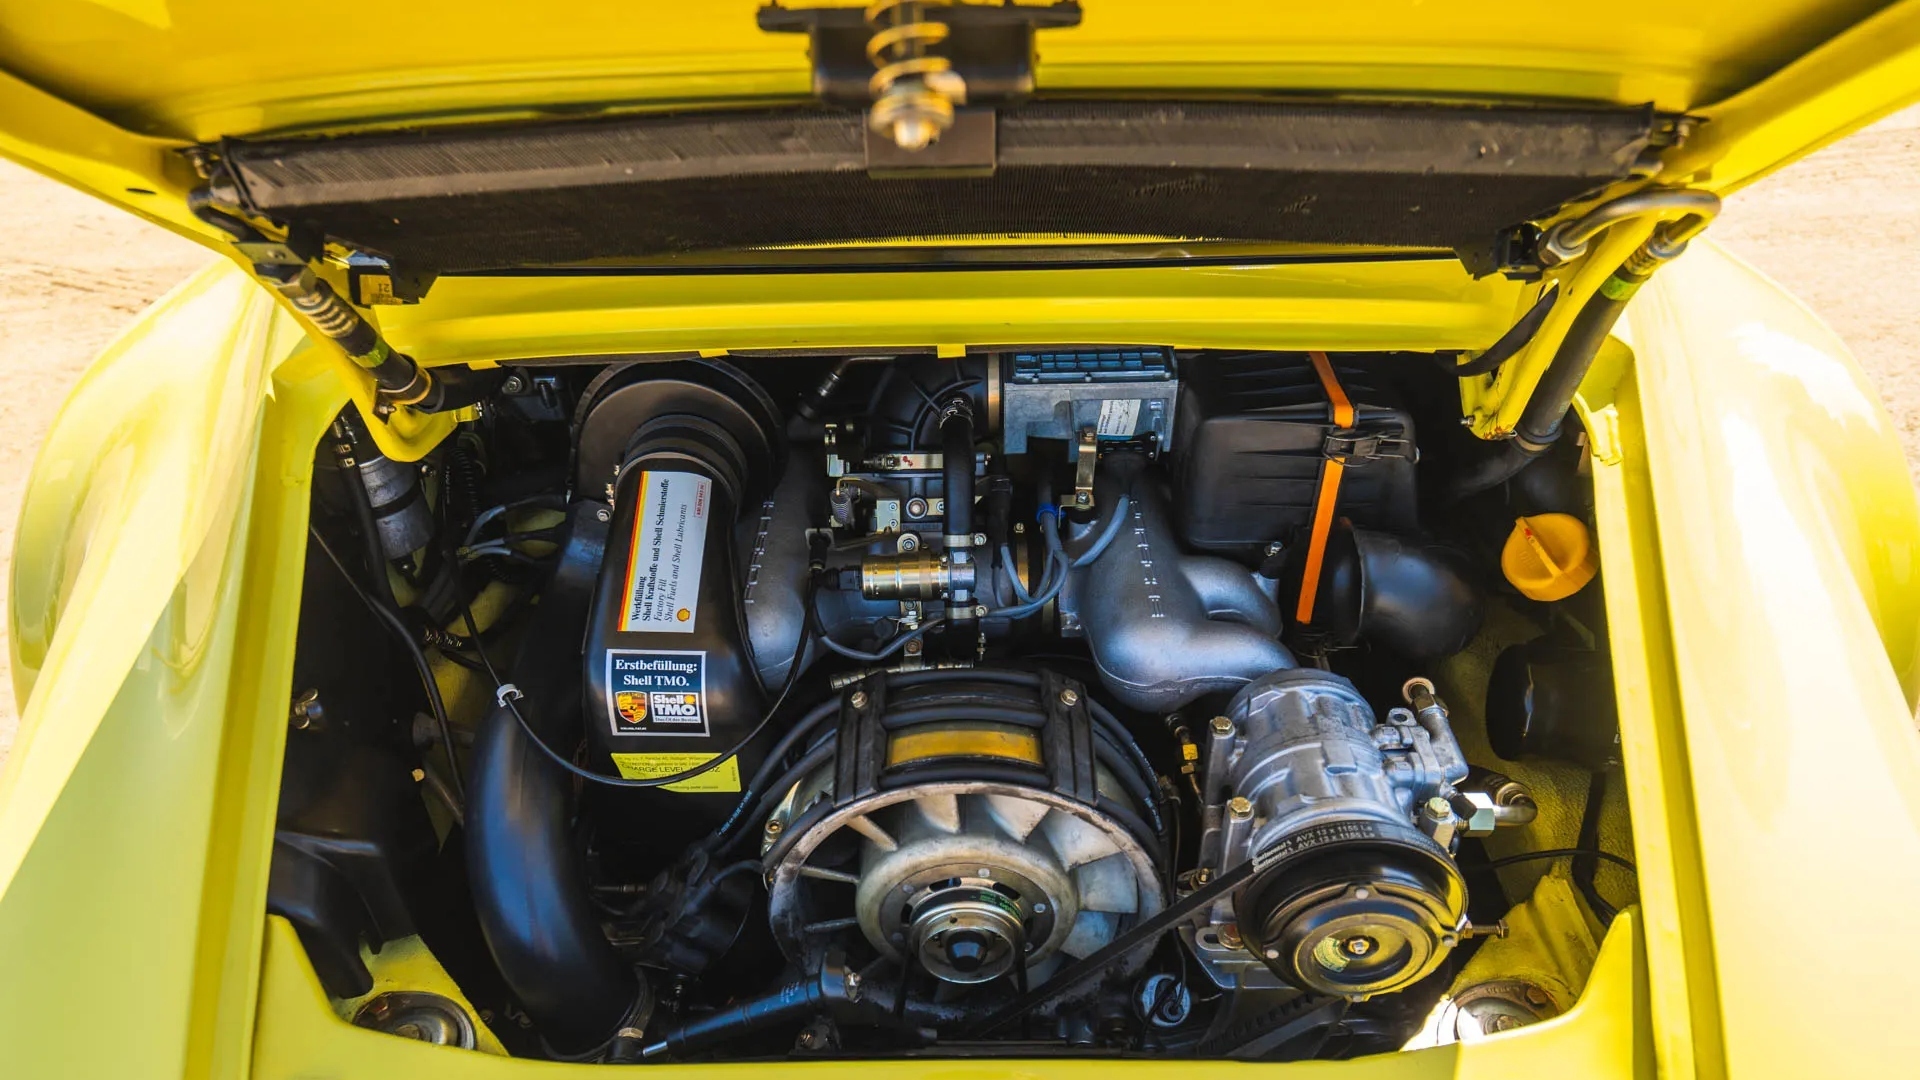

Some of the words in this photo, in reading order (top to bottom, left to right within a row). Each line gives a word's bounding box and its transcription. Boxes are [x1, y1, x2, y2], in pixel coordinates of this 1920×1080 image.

[656, 479, 669, 526] Schmierstoffe
[675, 503, 687, 543] Lubricants
[653, 527, 663, 546] Shell
[651, 548, 660, 562] und
[672, 543, 683, 563] Shell
[646, 563, 658, 600] Kraftstoffe
[671, 565, 680, 580] and
[658, 578, 667, 592] Fill
[668, 581, 677, 601] Fuels
[631, 576, 647, 621] Werkfüllung
[654, 593, 666, 622] Factory
[642, 602, 653, 622] Shell
[664, 602, 674, 622] Shell
[615, 659, 698, 674] Erstbefüllung:
[623, 675, 652, 686] Shell
[655, 675, 690, 687] TMO.
[654, 694, 684, 705] Shell
[655, 704, 696, 716] TMO
[1252, 841, 1287, 866] Continental
[1296, 832, 1314, 843] AVX
[1298, 840, 1317, 850] AVX
